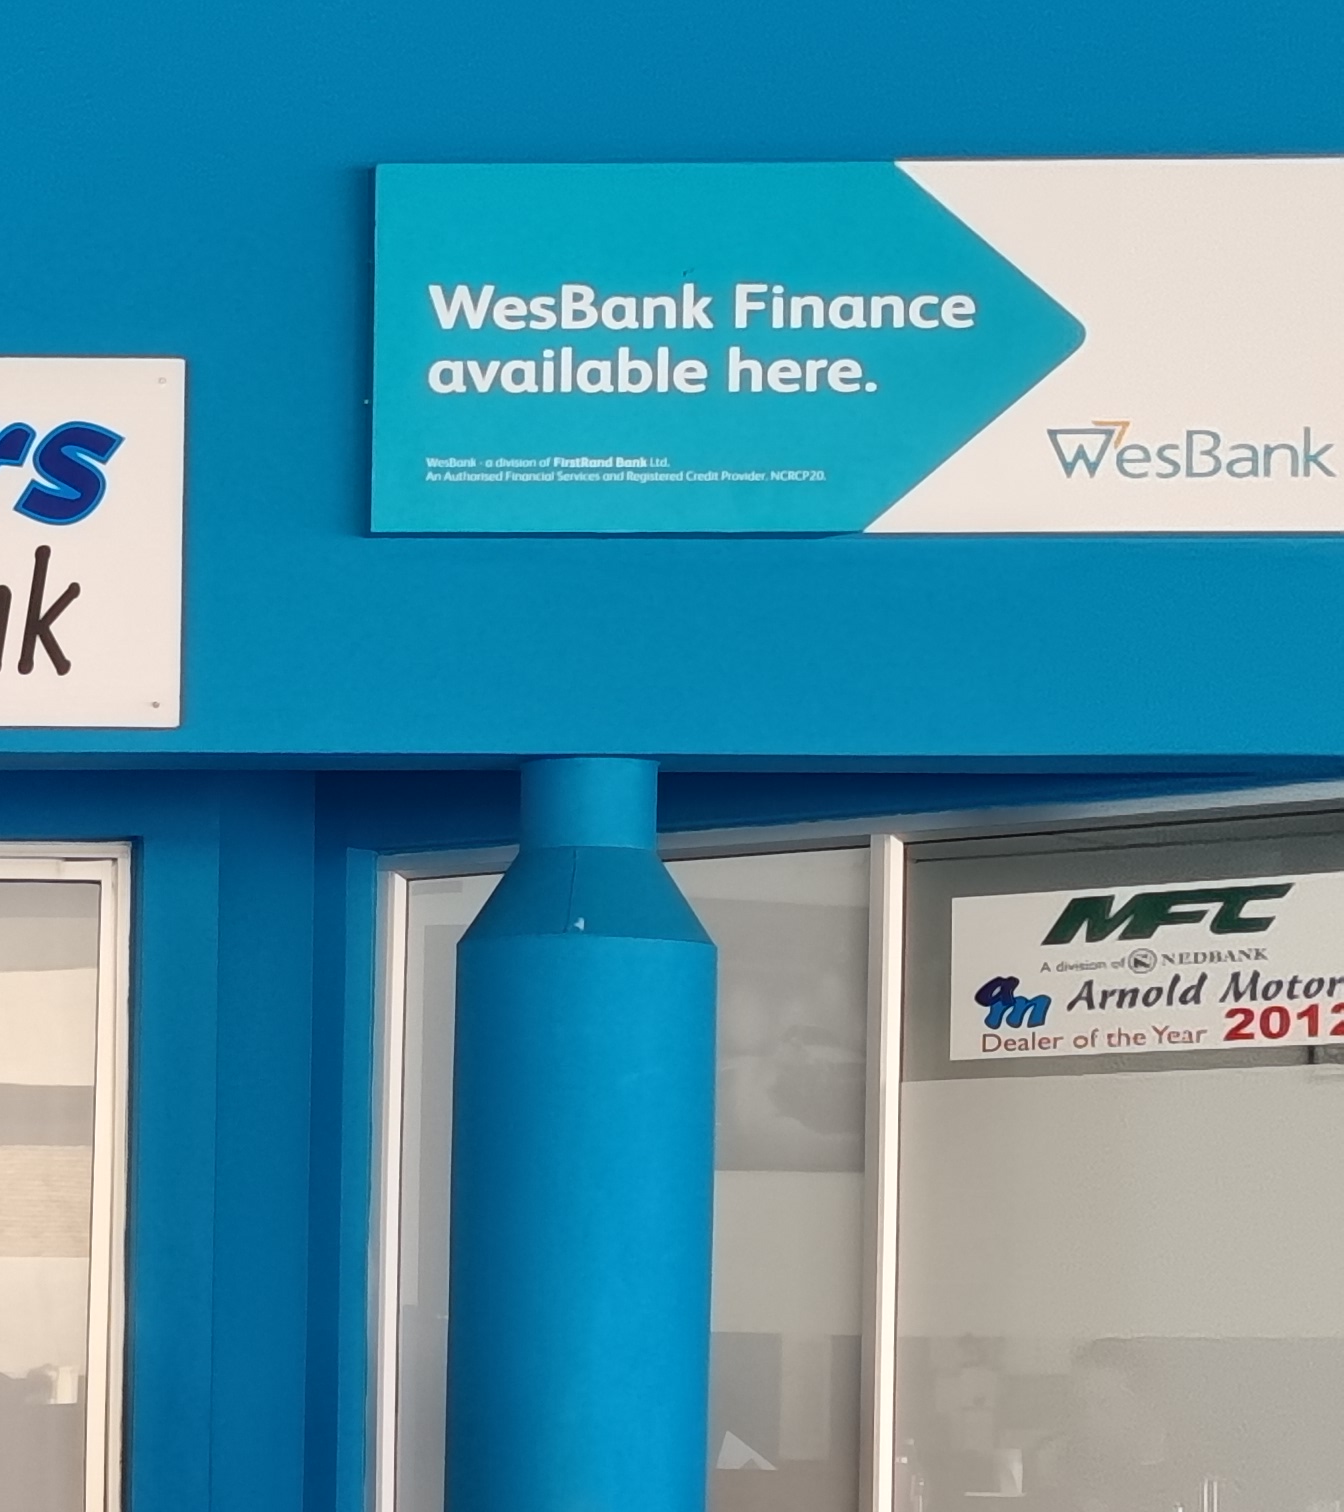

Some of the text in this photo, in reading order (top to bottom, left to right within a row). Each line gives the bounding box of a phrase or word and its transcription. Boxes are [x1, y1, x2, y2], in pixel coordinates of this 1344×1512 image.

[428, 283, 976, 330] WesBank Finance
[428, 346, 878, 393] available here.
[426, 457, 477, 468] WesBank
[495, 457, 537, 468] division
[539, 457, 551, 468] of
[553, 457, 613, 468] FirstRand
[615, 457, 647, 468] Bank
[1047, 421, 1338, 480] WesBank
[425, 471, 442, 481] An
[443, 471, 503, 481] Authorised
[505, 471, 555, 481] Financial
[556, 471, 600, 481] Services
[602, 471, 624, 481] and
[626, 471, 684, 484] Registered
[685, 471, 718, 481] Credit
[1041, 882, 1296, 946] MFC
[1040, 948, 1269, 973] A division of NEDBANK
[1066, 969, 1344, 1012] Arnold Motor
[981, 1031, 1064, 1053] Dealer
[1073, 1028, 1099, 1050] of
[1107, 1027, 1147, 1048] the
[1151, 1025, 1208, 1045] Year
